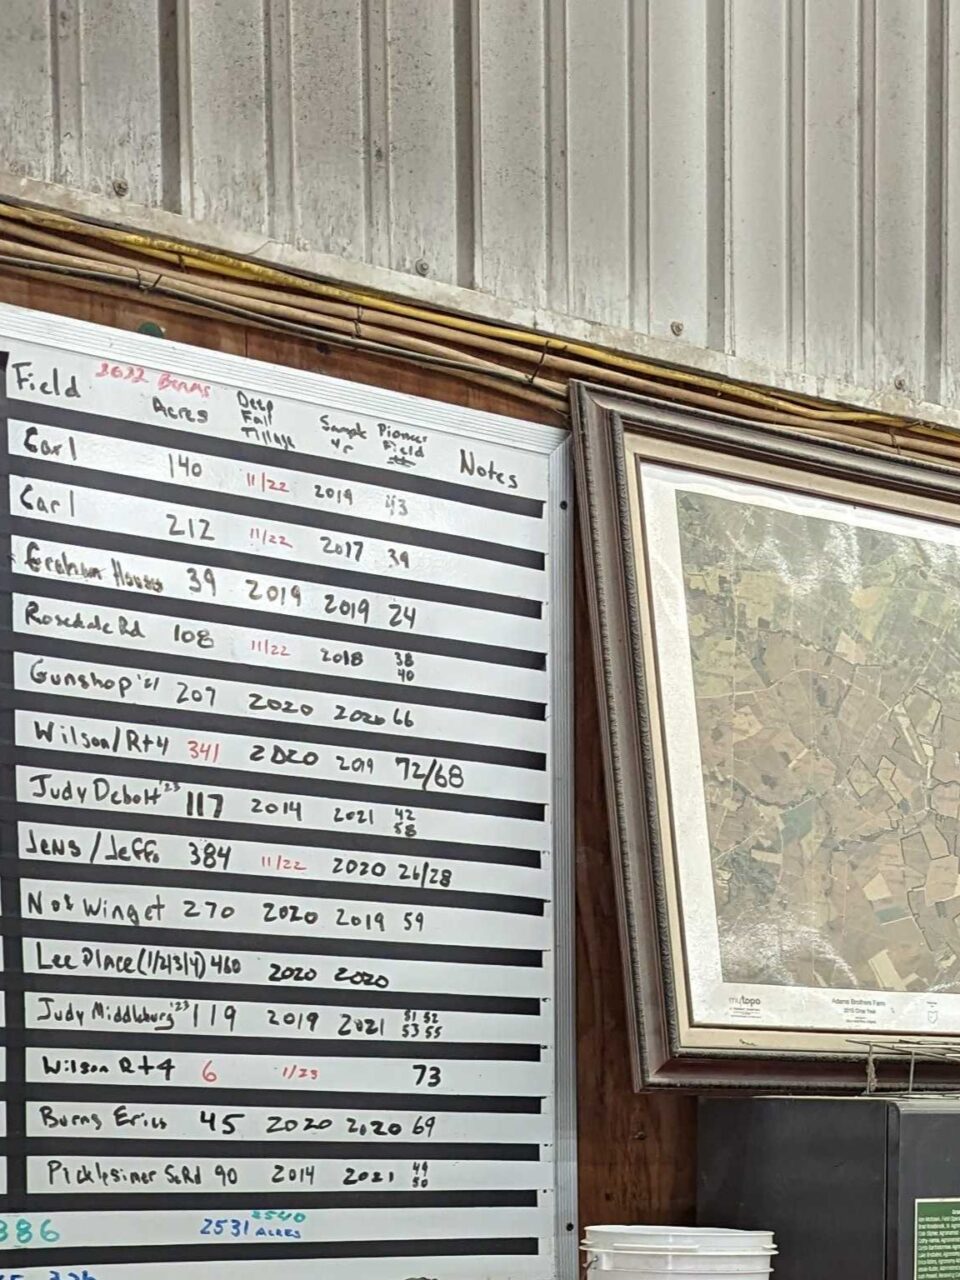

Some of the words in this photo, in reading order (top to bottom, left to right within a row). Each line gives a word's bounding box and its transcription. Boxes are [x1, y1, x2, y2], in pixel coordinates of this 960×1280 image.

[12, 362, 82, 398] Field
[152, 396, 209, 423] Acres
[24, 426, 78, 461] Carl
[168, 453, 203, 479] 140
[246, 472, 291, 493] 11/22
[460, 449, 519, 490] Notes
[20, 484, 76, 517] Carl
[166, 513, 216, 541] 212
[250, 527, 293, 549] 11/22
[320, 536, 364, 562] 2017
[187, 567, 216, 597] 39
[245, 579, 302, 607] 2019
[324, 594, 371, 625] 2019
[388, 603, 417, 630] 24
[174, 624, 215, 649] 108
[250, 639, 291, 657] 11/22
[320, 648, 364, 667] 2018
[249, 693, 314, 716] 2020
[187, 740, 221, 764] 341
[249, 745, 319, 766] 2020
[395, 756, 465, 791] 72/68
[29, 774, 87, 803] Judy
[186, 790, 225, 819] 117
[250, 798, 303, 822] 2014
[333, 807, 374, 825] 2021
[188, 841, 232, 870] 384
[261, 855, 308, 871] 11/22
[332, 858, 387, 878] 2020
[398, 861, 453, 888] 26/28
[183, 898, 236, 920] 270
[262, 903, 319, 925] 2020
[336, 908, 386, 933] 2019
[403, 912, 425, 932] 59
[36, 942, 78, 971] Lee
[268, 963, 318, 983] 2020
[334, 967, 390, 989] 2020
[37, 997, 85, 1026] Judy
[267, 1010, 320, 1033] 2019
[337, 1014, 385, 1038] 2021
[42, 1056, 110, 1077] Wilson
[201, 1059, 218, 1083] 6
[412, 1065, 442, 1088] 73
[200, 1111, 245, 1135] 45
[266, 1114, 333, 1133] 2020
[412, 1115, 436, 1138] 69
[214, 1166, 239, 1186] 90
[271, 1164, 315, 1186] 2014
[200, 1218, 249, 1237] 2531
